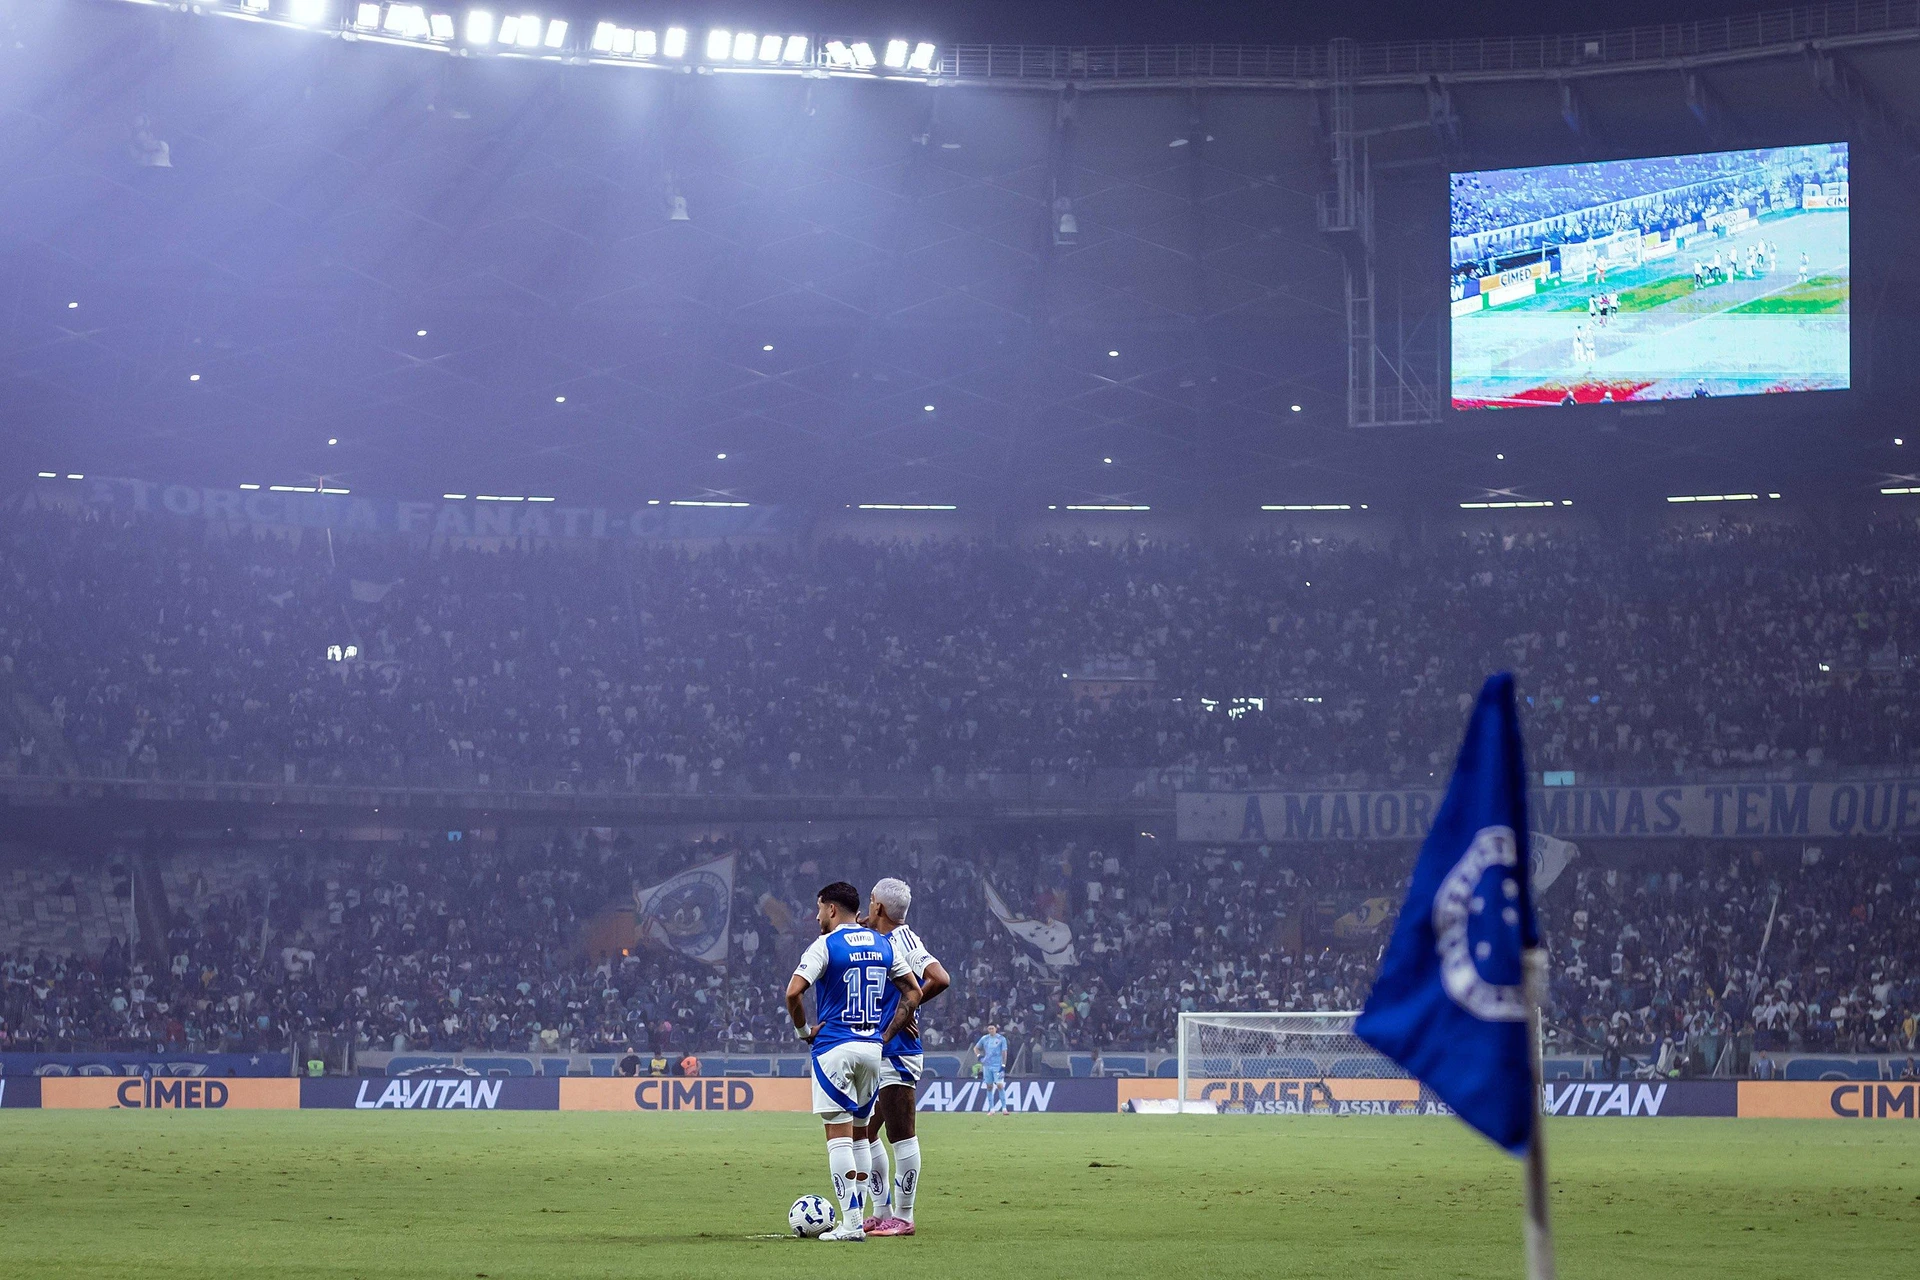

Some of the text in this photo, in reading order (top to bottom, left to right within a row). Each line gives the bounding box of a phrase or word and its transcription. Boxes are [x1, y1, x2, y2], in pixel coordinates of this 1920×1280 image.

[1500, 268, 1532, 287] CIMED
[1239, 795, 1267, 839] A
[1283, 792, 1433, 839] MAIOR
[1703, 783, 1812, 834] TEM
[1829, 781, 1920, 836] QUE
[849, 951, 883, 962] WILLIAM
[842, 966, 887, 1024] 12
[355, 1080, 503, 1109] LAVITAN
[635, 1080, 754, 1110] CIMED
[916, 1081, 1055, 1111] AVITAN
[1541, 1083, 1668, 1116] VITAN
[1830, 1085, 1920, 1118] CIM
